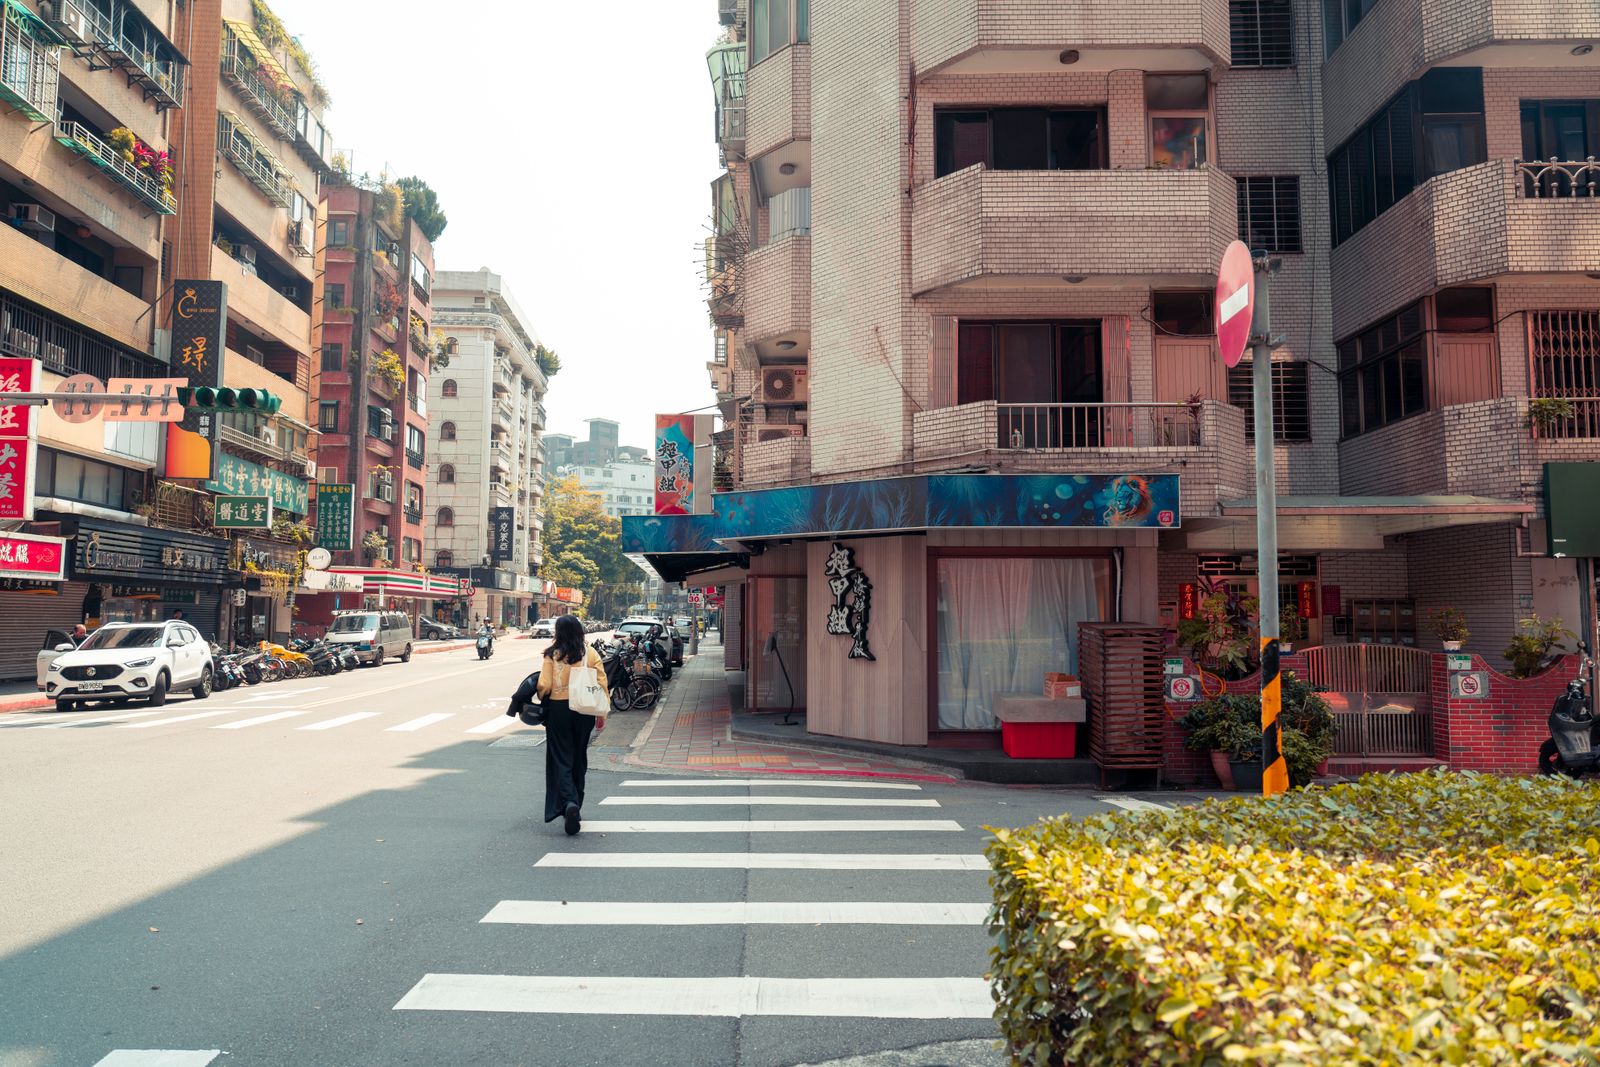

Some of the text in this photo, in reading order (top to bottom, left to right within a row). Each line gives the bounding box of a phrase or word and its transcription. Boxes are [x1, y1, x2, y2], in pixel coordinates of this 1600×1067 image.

[657, 439, 683, 493] 超甲組
[217, 502, 266, 522] 醫道堂
[689, 595, 700, 603] 30
[825, 542, 855, 634] 超甲組
